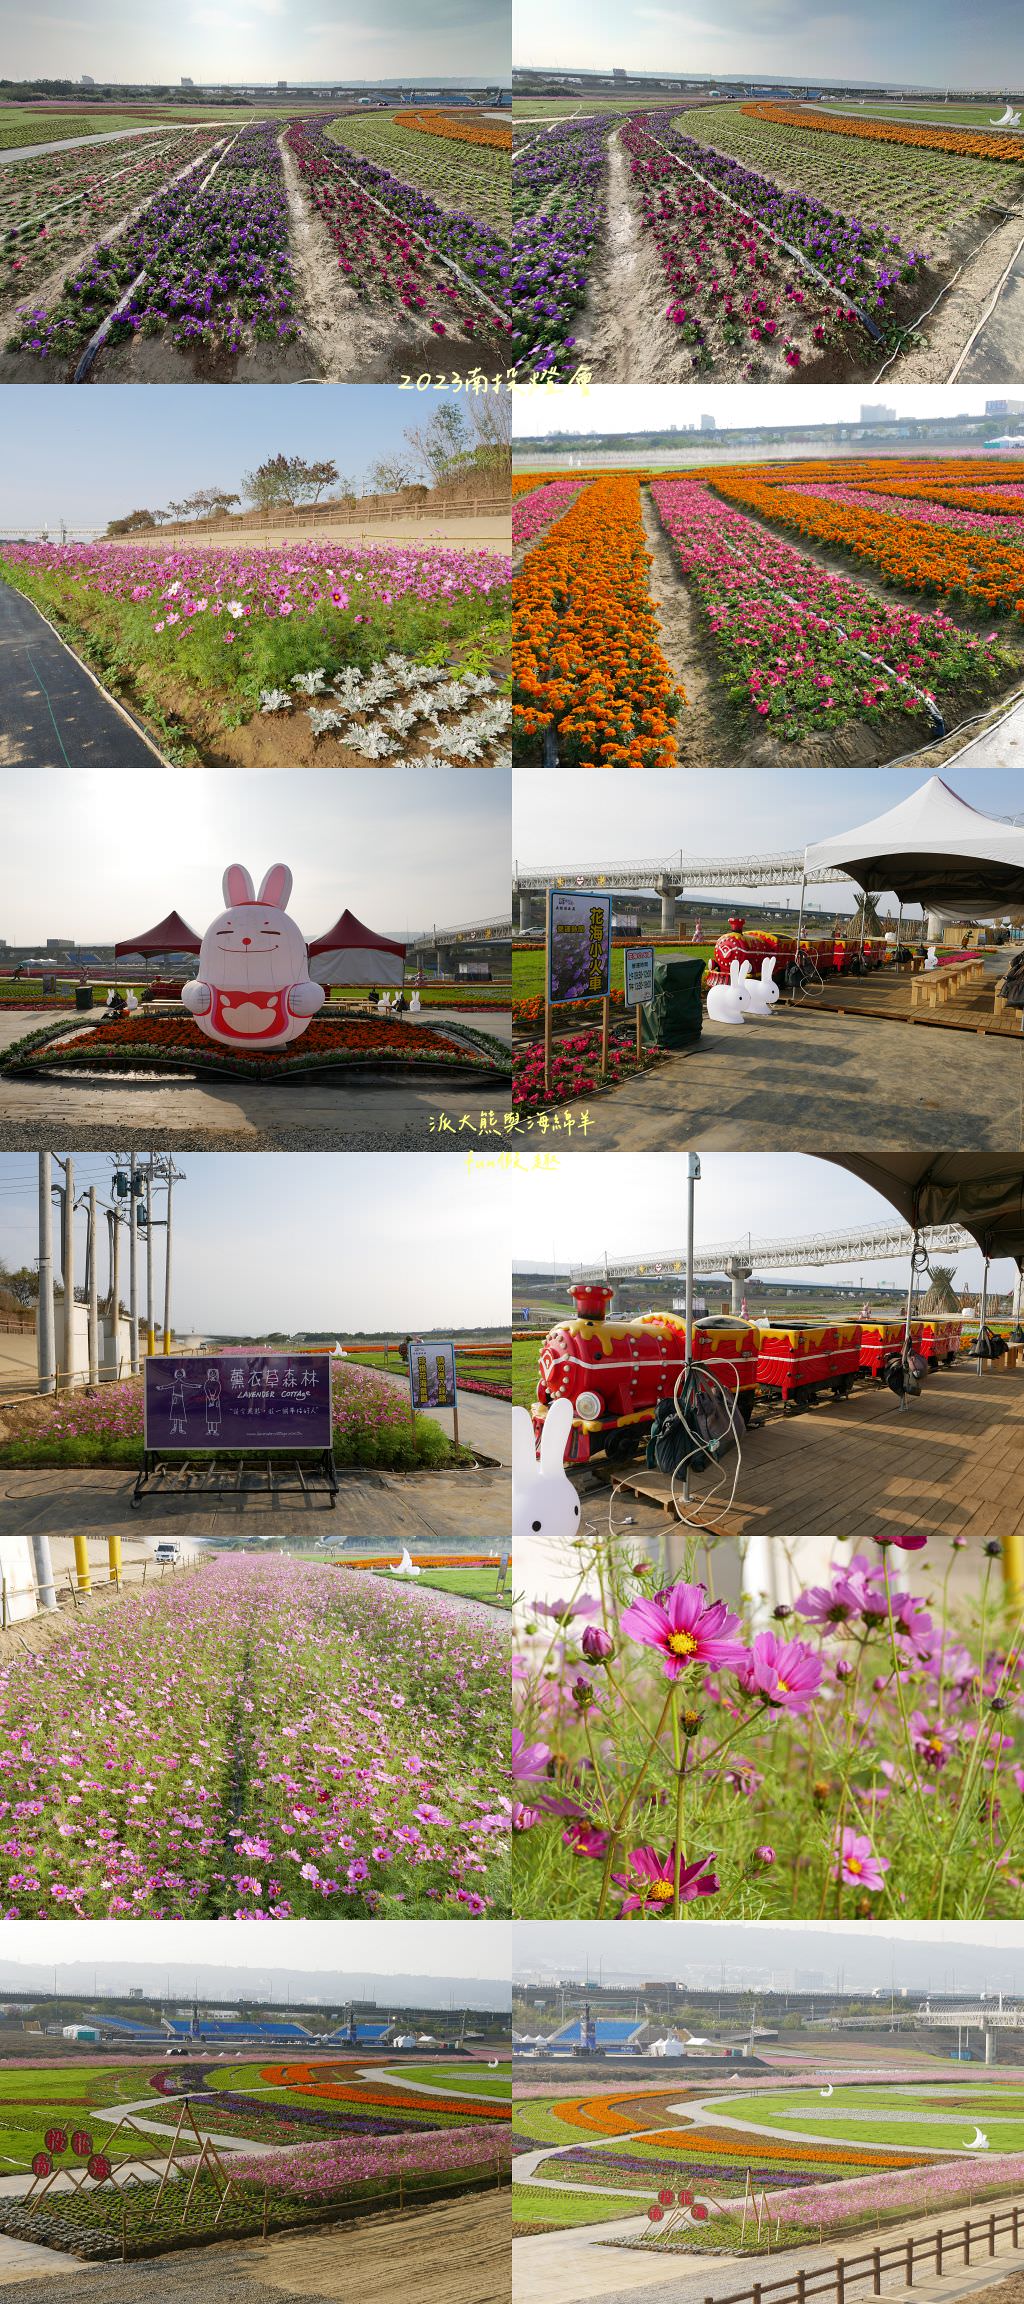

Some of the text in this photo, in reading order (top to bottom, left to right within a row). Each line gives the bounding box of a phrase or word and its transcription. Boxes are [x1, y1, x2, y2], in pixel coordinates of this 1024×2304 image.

[588, 907, 605, 992] 花海小火車
[230, 1368, 320, 1389] 薰衣草森林
